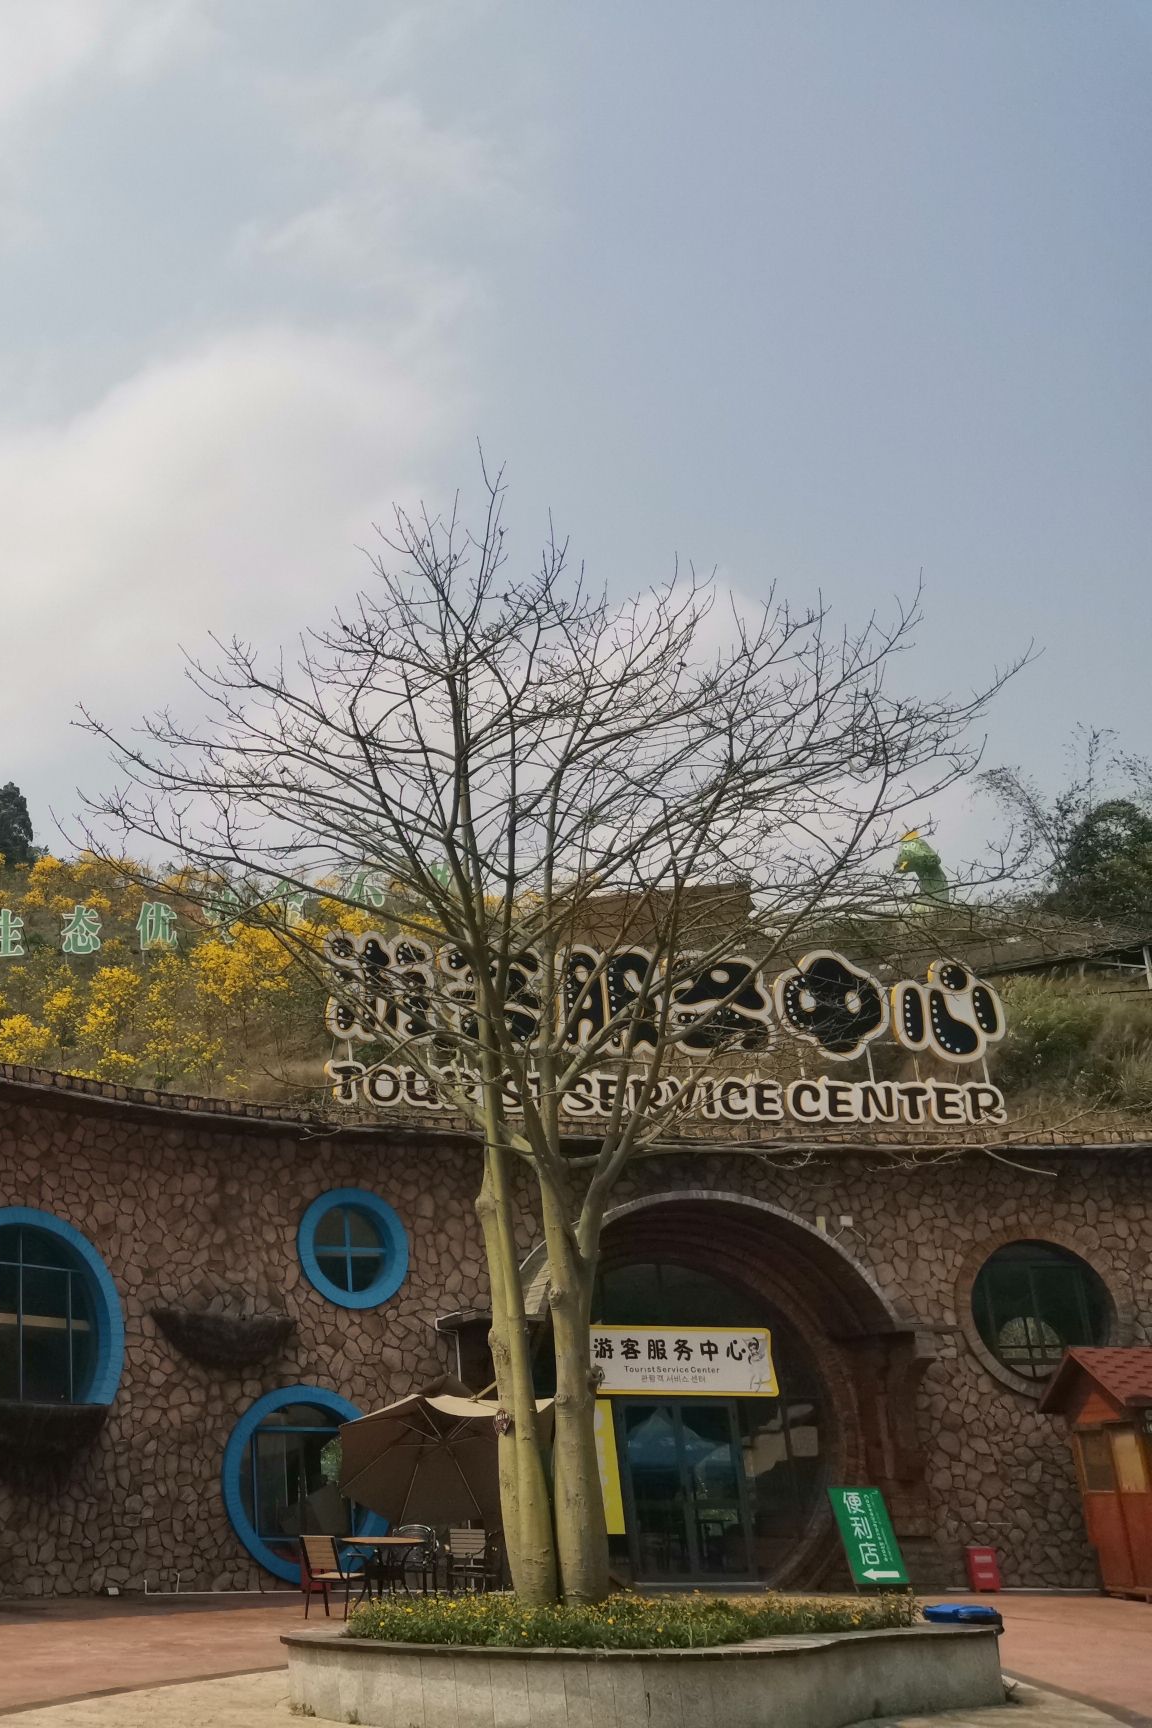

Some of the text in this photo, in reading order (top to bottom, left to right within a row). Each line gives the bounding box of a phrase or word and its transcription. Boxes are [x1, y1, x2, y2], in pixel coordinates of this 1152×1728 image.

[561, 1074, 784, 1121] SERVICE
[787, 1078, 1006, 1124] CENTER
[593, 1337, 746, 1361] 游客服务中心
[843, 1491, 879, 1565] 便利店
